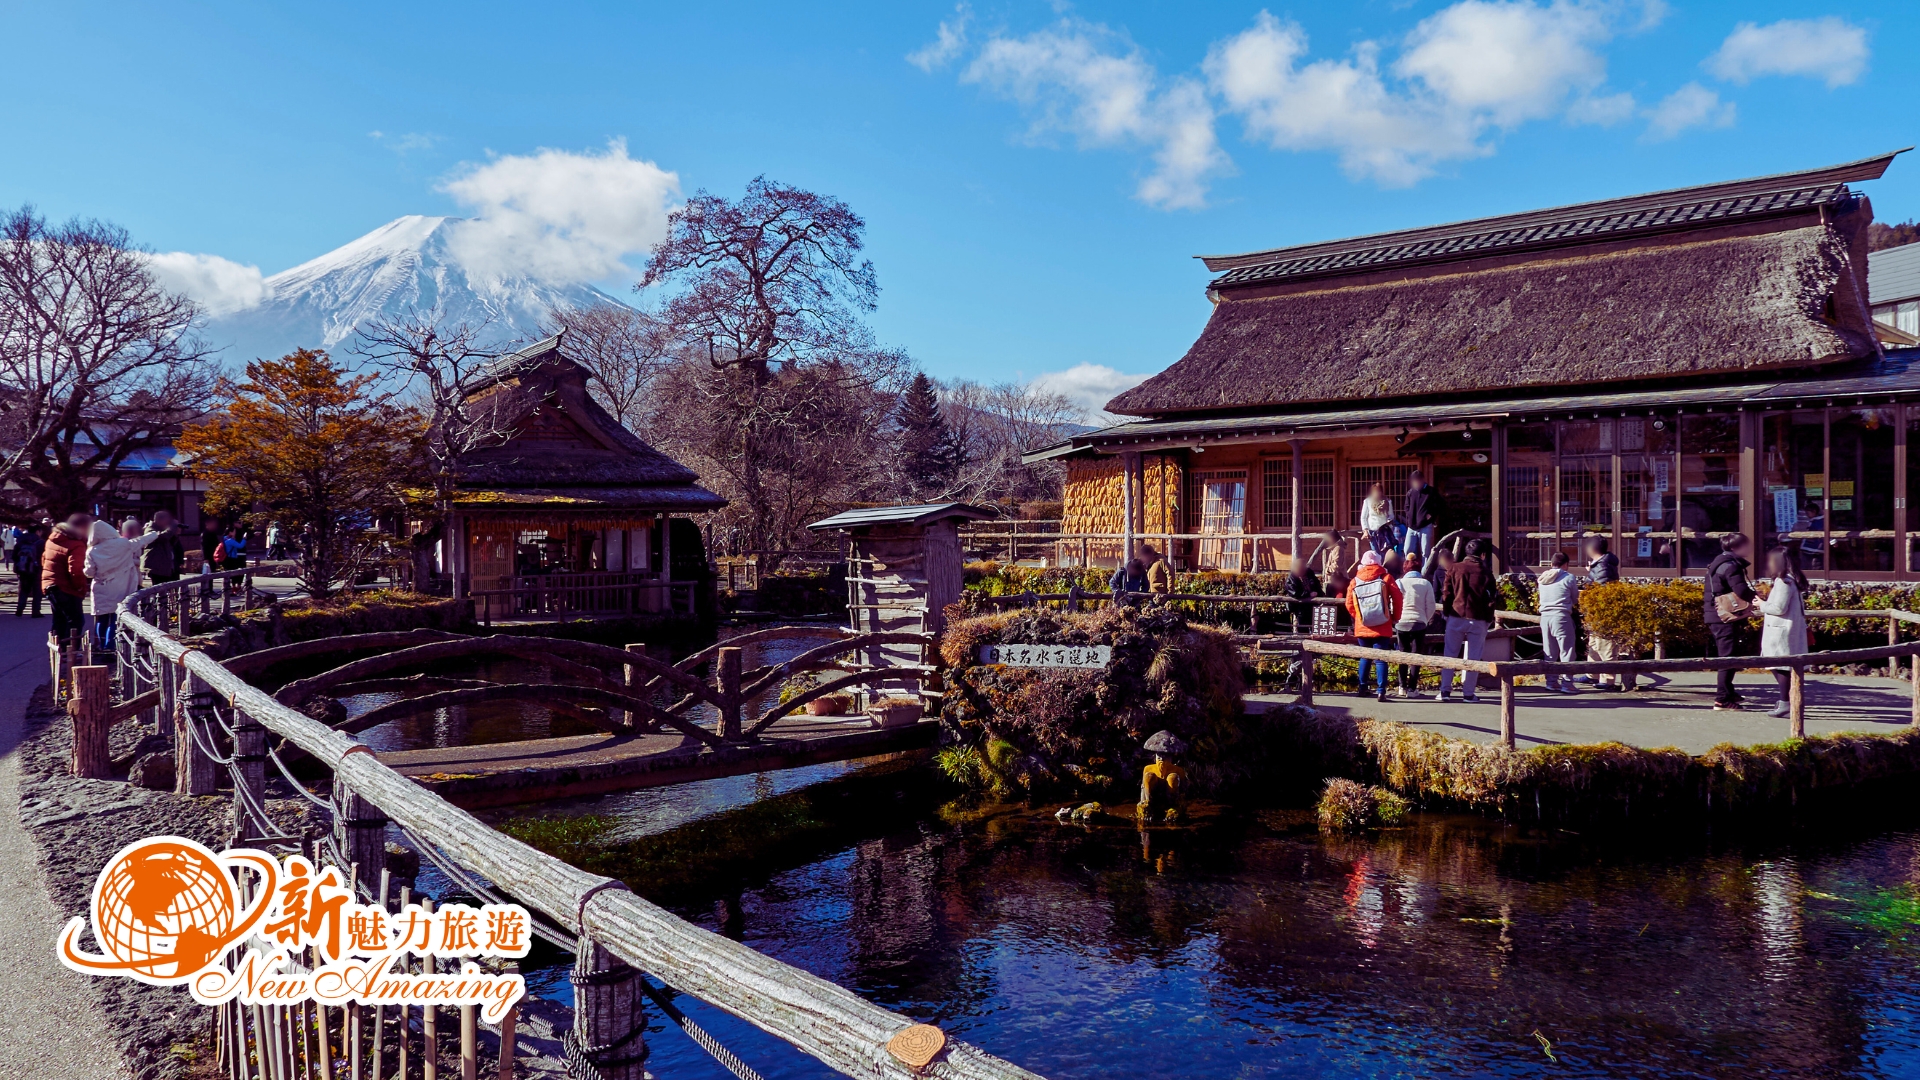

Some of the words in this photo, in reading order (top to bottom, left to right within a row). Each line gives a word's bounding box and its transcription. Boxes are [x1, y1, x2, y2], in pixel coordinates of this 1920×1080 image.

[990, 649, 1101, 666] 日本名水百選地
